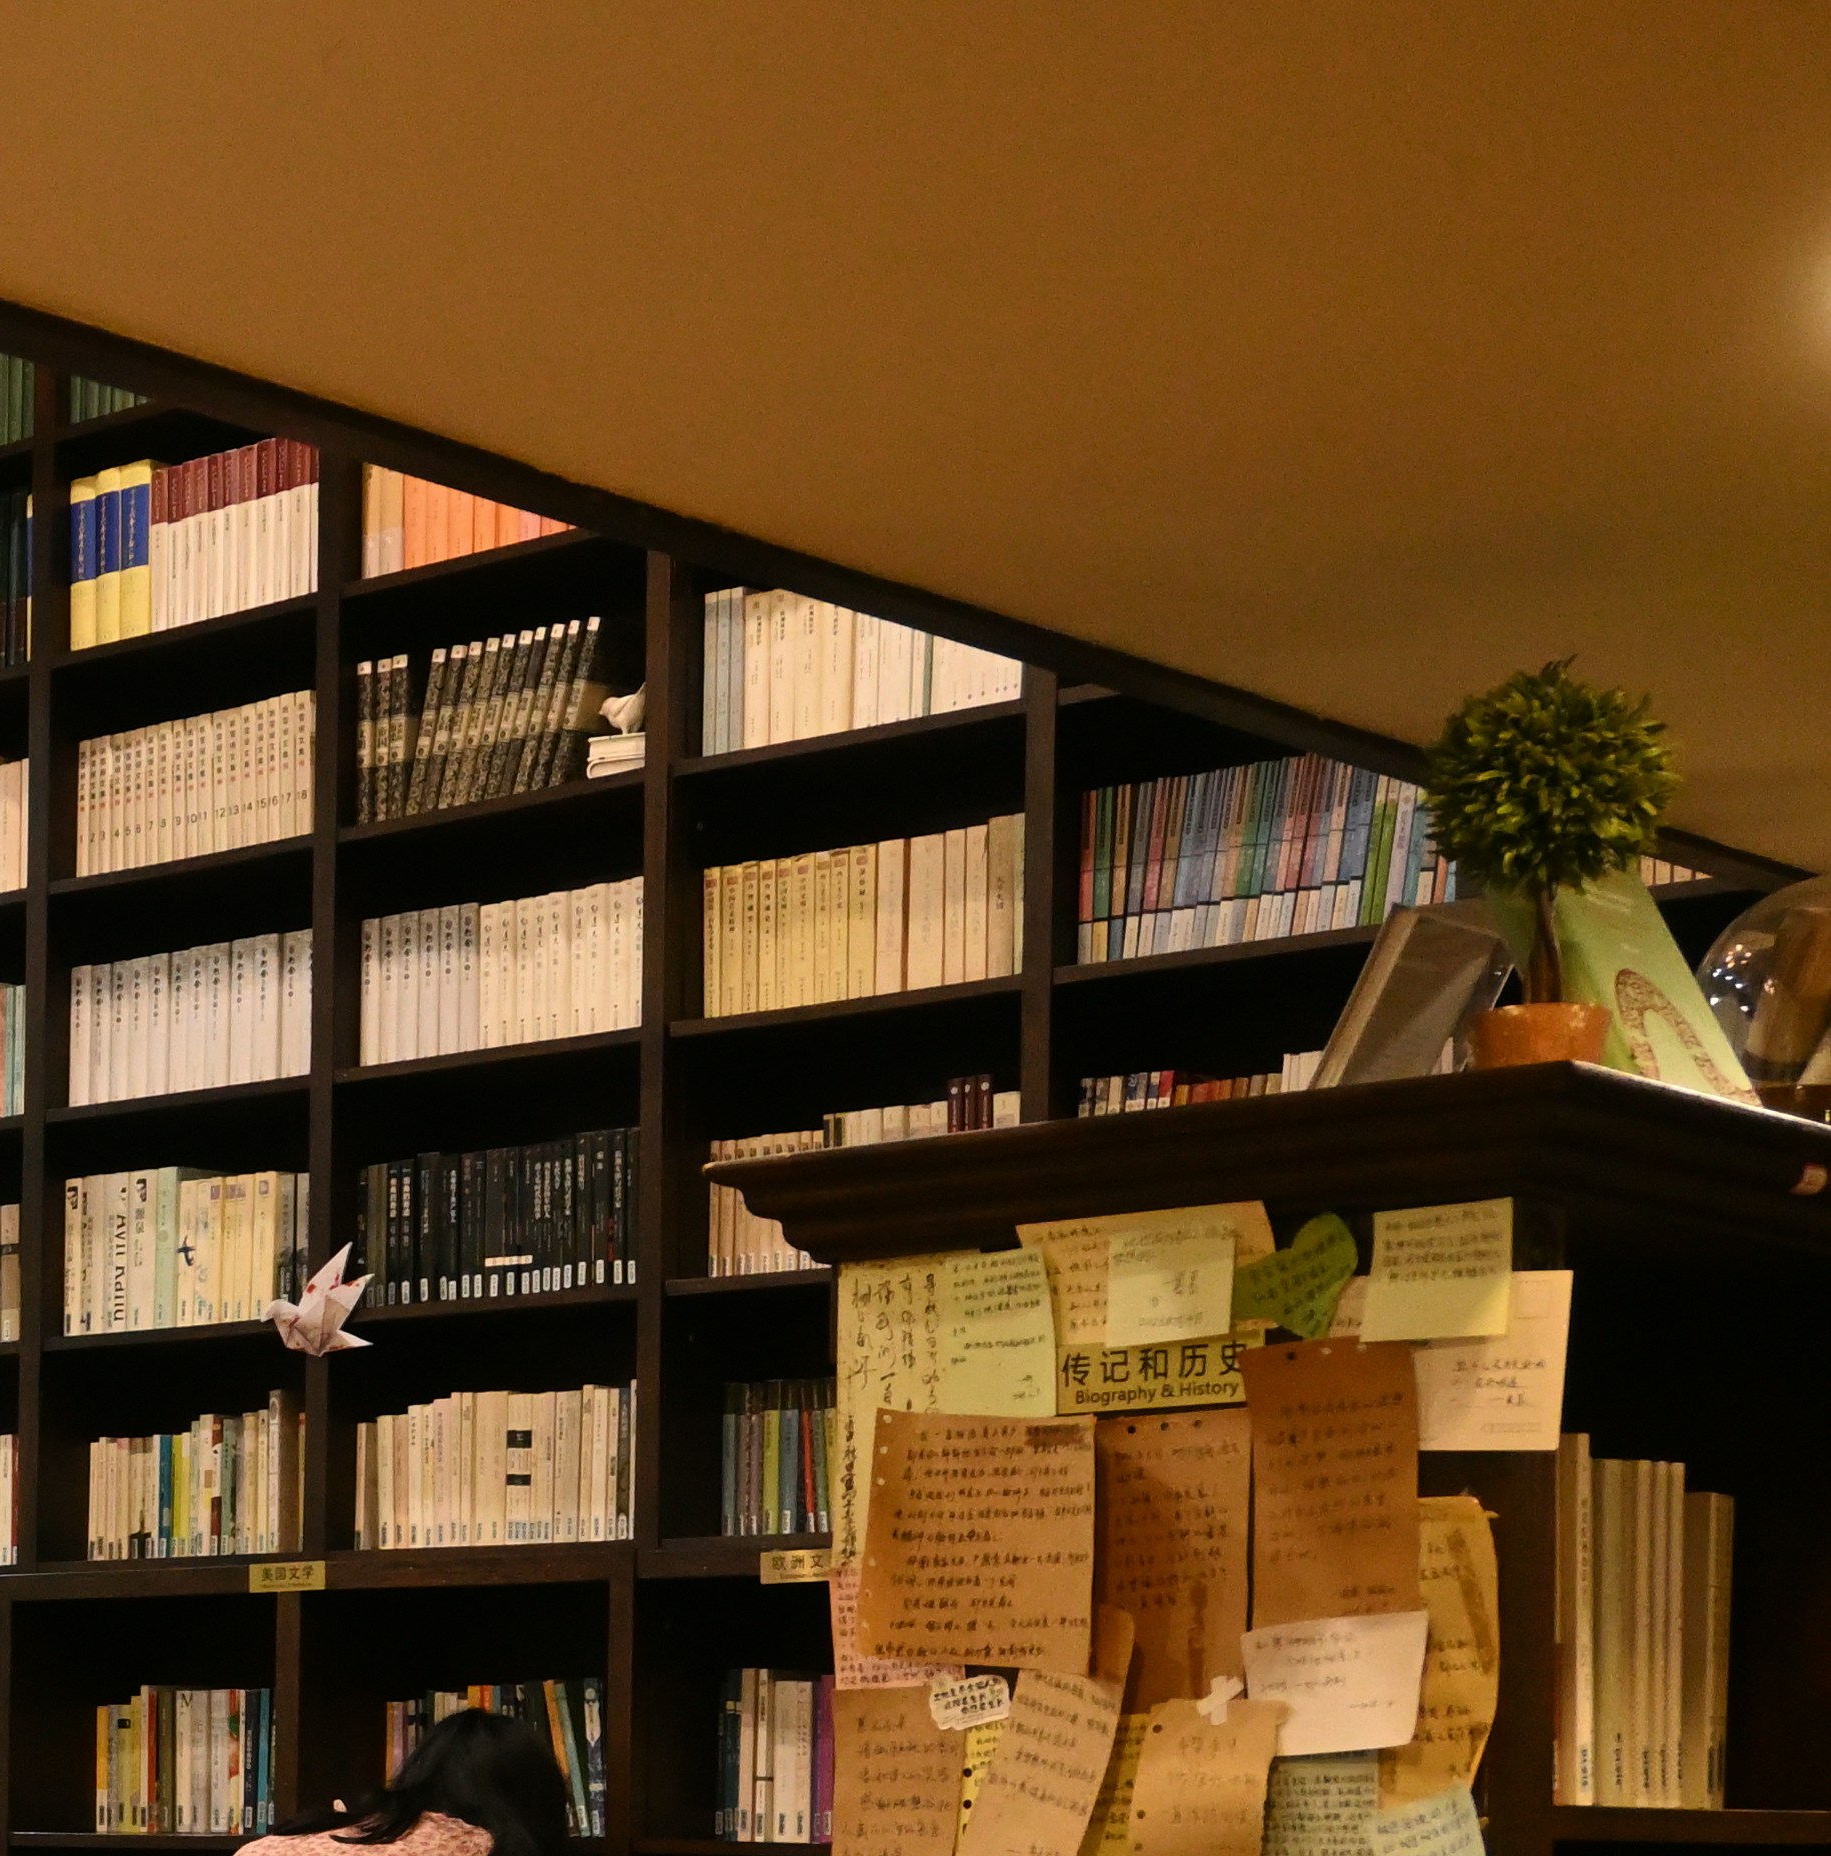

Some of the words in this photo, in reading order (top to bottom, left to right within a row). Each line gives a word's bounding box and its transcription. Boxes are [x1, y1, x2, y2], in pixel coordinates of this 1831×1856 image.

[281, 792, 291, 802] 17
[297, 789, 307, 800] 18
[257, 797, 266, 809] 15
[268, 795, 278, 806] 16
[215, 807, 225, 818] 12
[228, 804, 239, 816] 13
[242, 802, 252, 812] 14
[1062, 1341, 1248, 1388] 传记和历史
[1075, 1384, 1158, 1407] Biography
[1161, 1380, 1176, 1398] &
[1179, 1381, 1240, 1399] History
[262, 1565, 314, 1582] 美国文学
